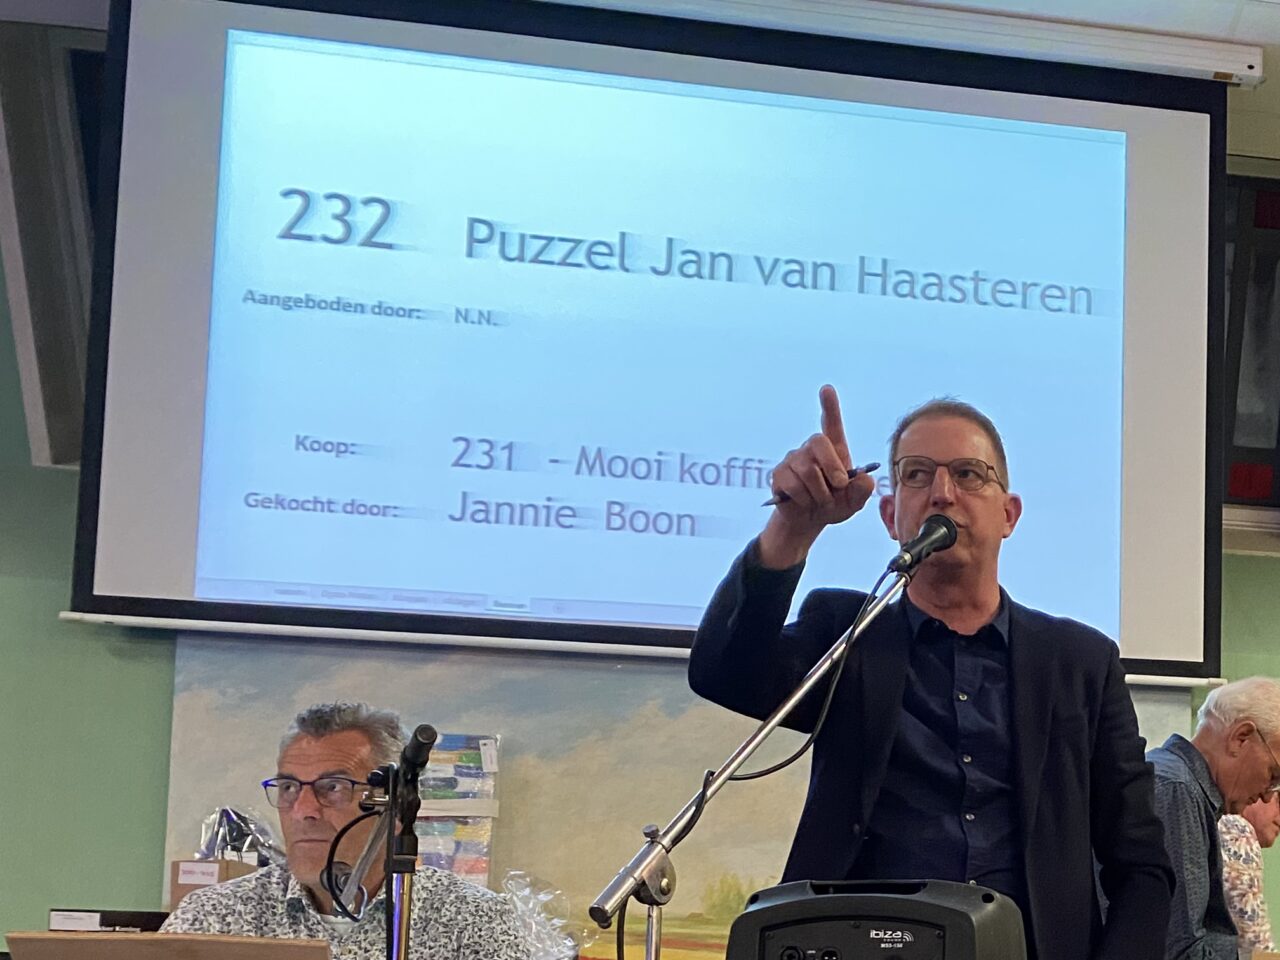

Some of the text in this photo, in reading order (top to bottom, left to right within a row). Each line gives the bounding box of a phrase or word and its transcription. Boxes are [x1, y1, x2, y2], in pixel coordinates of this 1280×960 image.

[276, 187, 395, 251] 232
[465, 216, 1093, 316] Puzzel Jan van Haasteren
[243, 289, 366, 315] Aangeboden
[370, 300, 421, 320] door:
[294, 434, 356, 458] Koop:
[451, 436, 516, 472] 231
[575, 445, 664, 482] Mooi
[243, 492, 400, 518] Gekocht door:
[448, 491, 697, 538] Jannie Boon
[870, 929, 902, 939] ibiza
